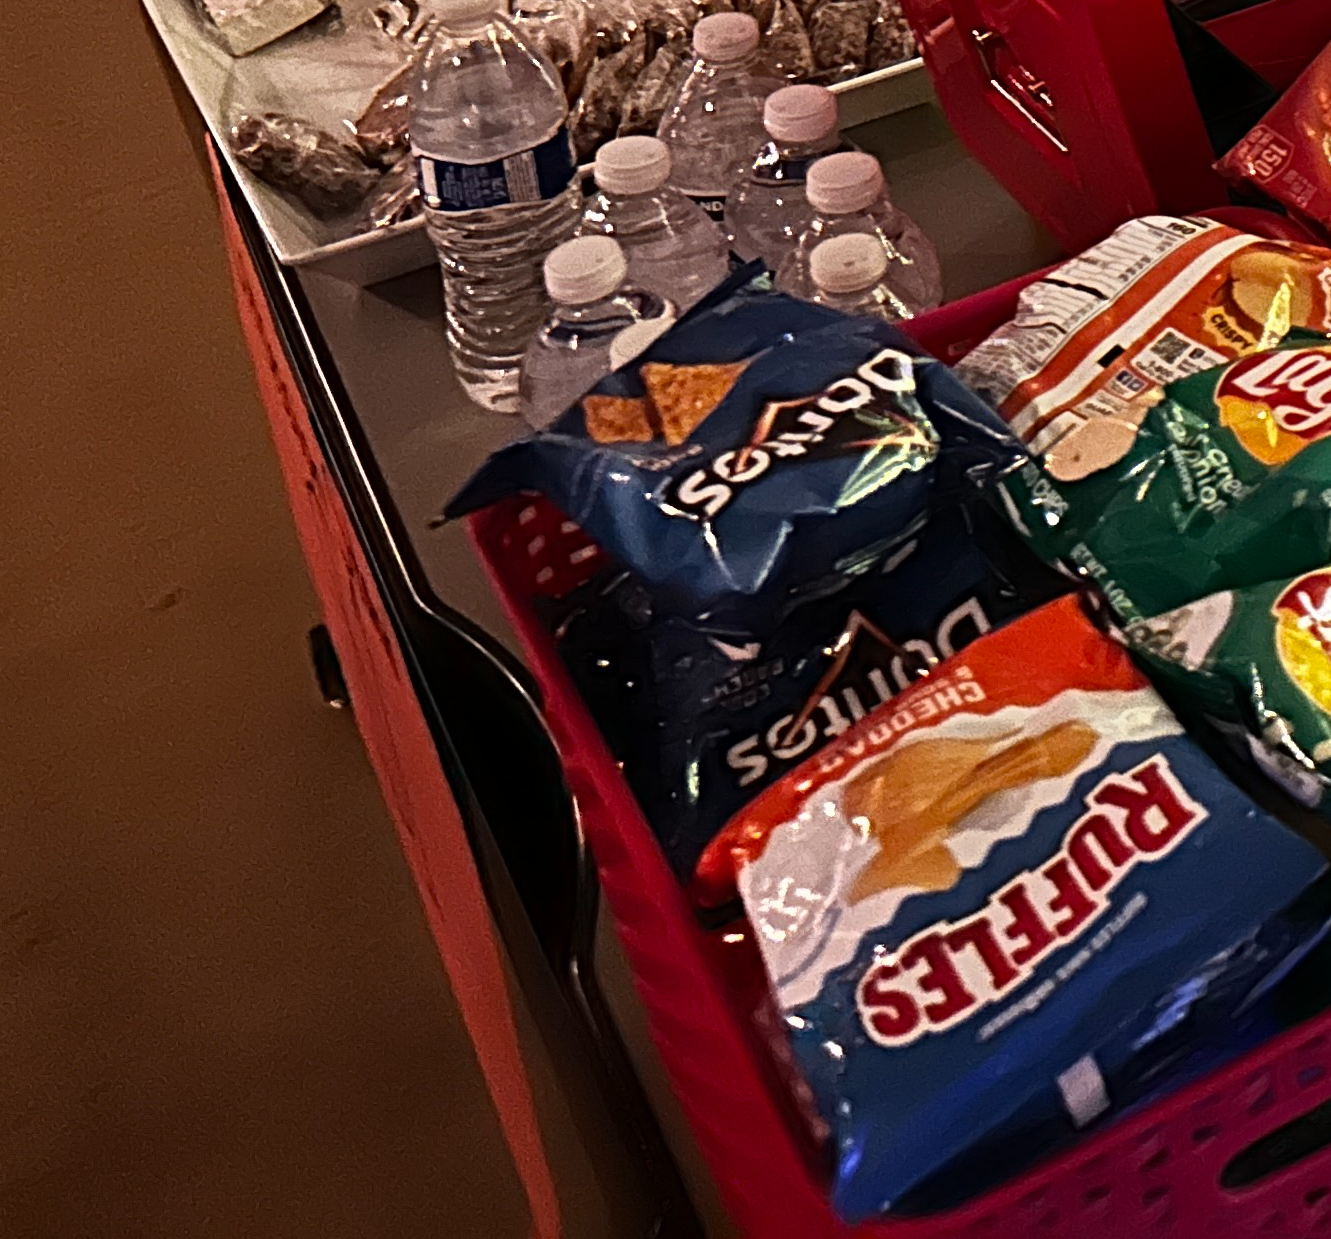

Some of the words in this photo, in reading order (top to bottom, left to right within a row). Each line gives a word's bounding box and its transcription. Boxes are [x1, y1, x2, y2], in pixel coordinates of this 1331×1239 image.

[1254, 136, 1289, 179] 150
[1166, 222, 1197, 235] 160
[1210, 313, 1251, 349] CRISPY
[678, 348, 916, 516] Doritos
[818, 680, 987, 774] CHEDDAR
[859, 756, 1206, 1044] RUFFLES
